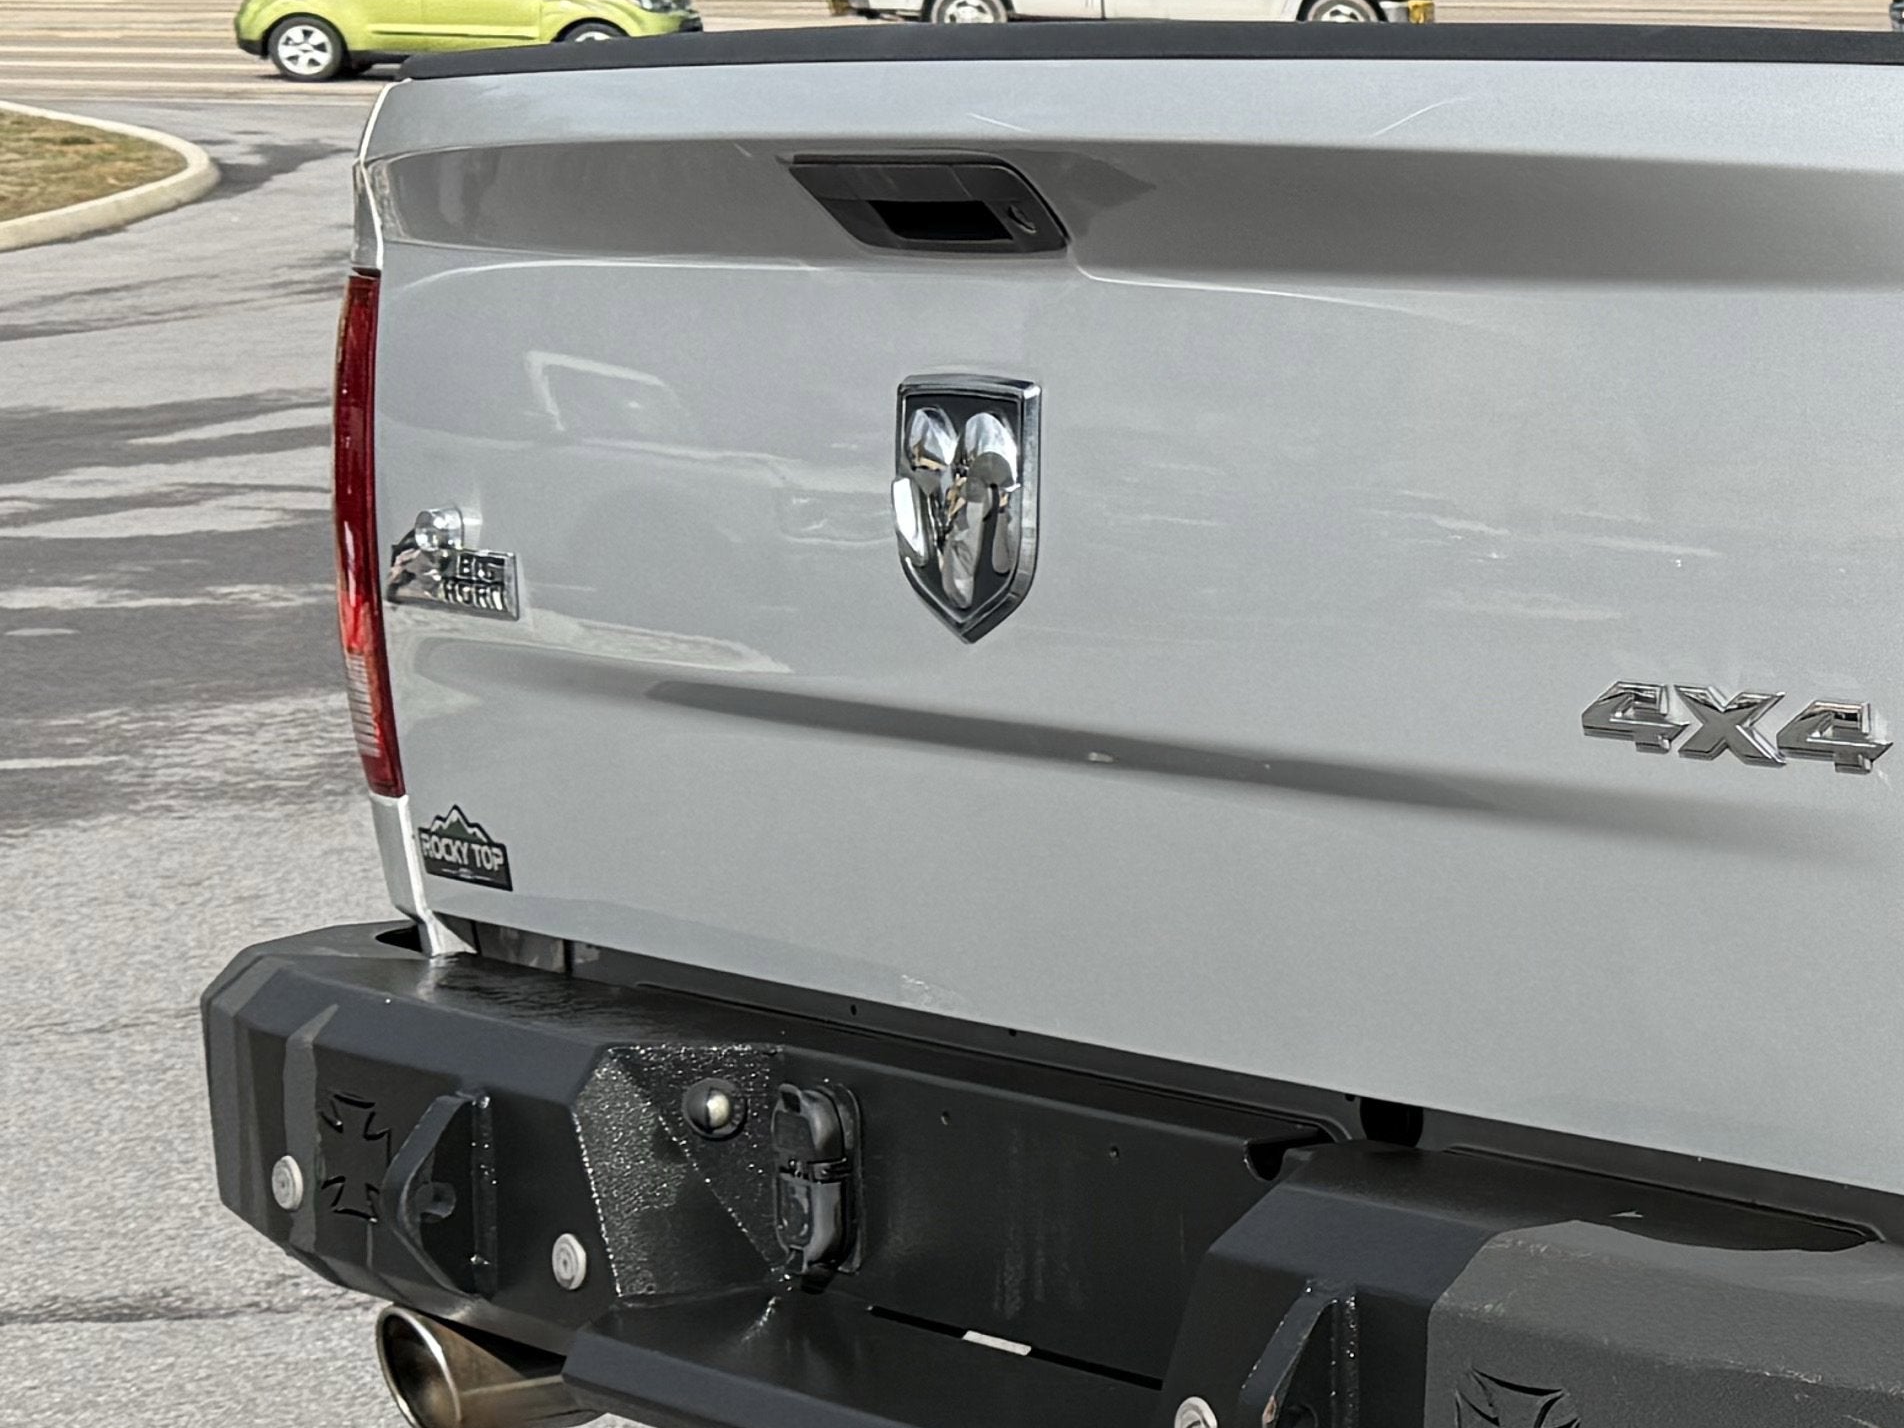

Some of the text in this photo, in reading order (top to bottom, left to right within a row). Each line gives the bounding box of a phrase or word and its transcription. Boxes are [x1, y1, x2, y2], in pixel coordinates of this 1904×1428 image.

[458, 553, 504, 583] BIG
[441, 579, 507, 611] HORN
[1580, 680, 1894, 775] 4X4
[420, 832, 504, 871] ROCKY TOP
